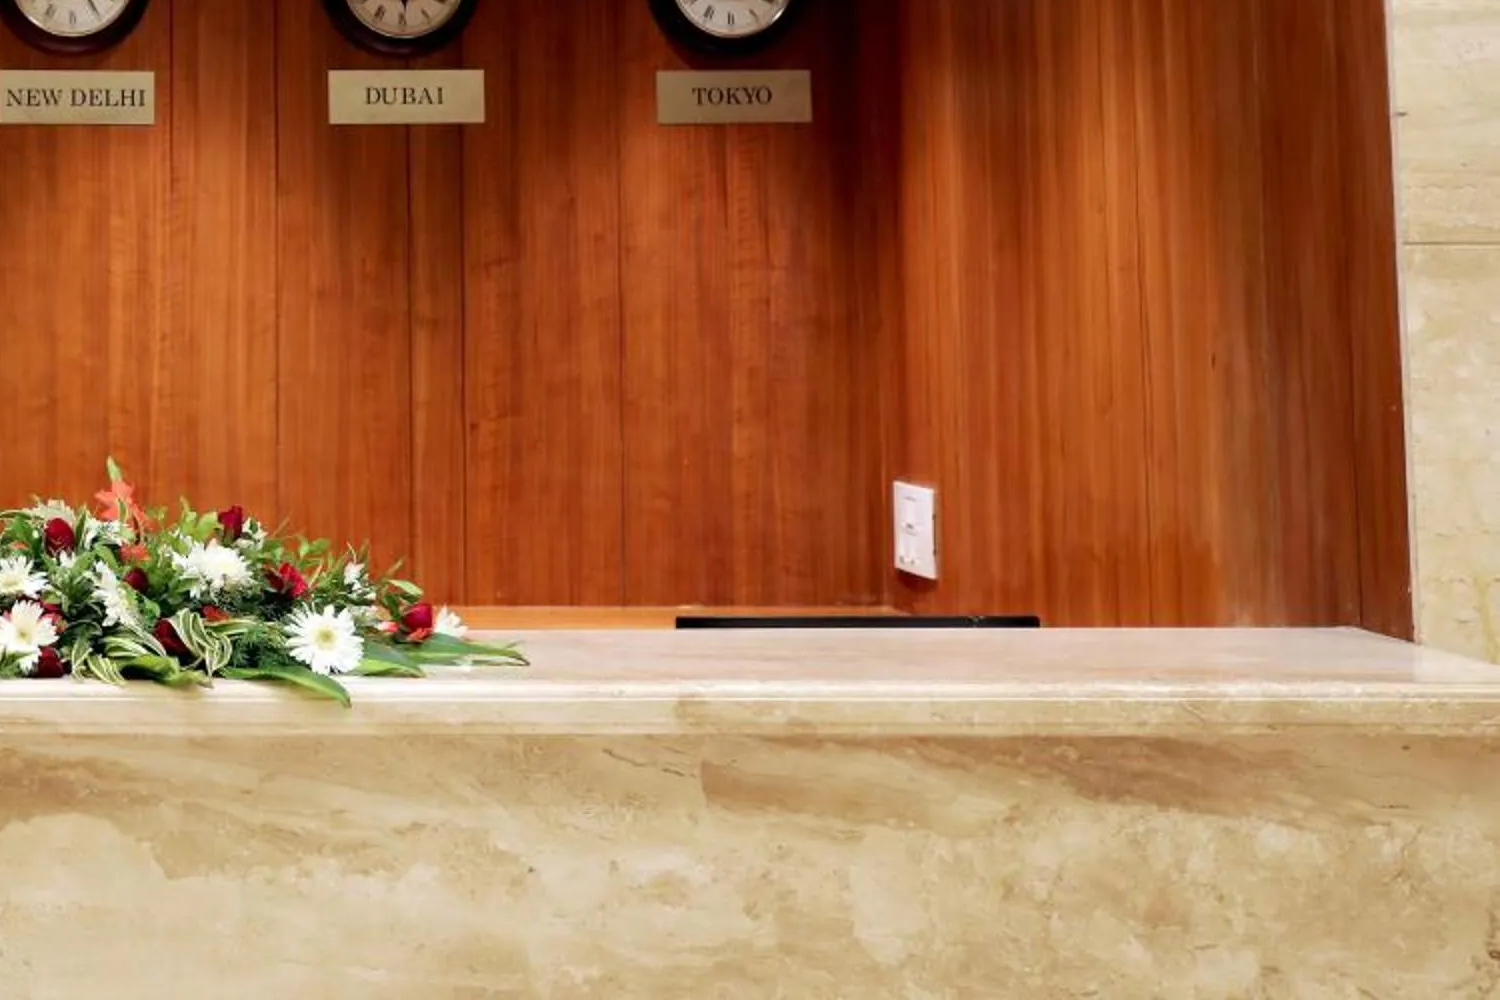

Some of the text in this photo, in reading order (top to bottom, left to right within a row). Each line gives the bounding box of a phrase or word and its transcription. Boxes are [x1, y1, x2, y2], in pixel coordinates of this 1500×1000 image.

[5, 87, 146, 107] NEW DELHI
[365, 86, 444, 106] DUBAI
[692, 85, 773, 106] TOKYO
